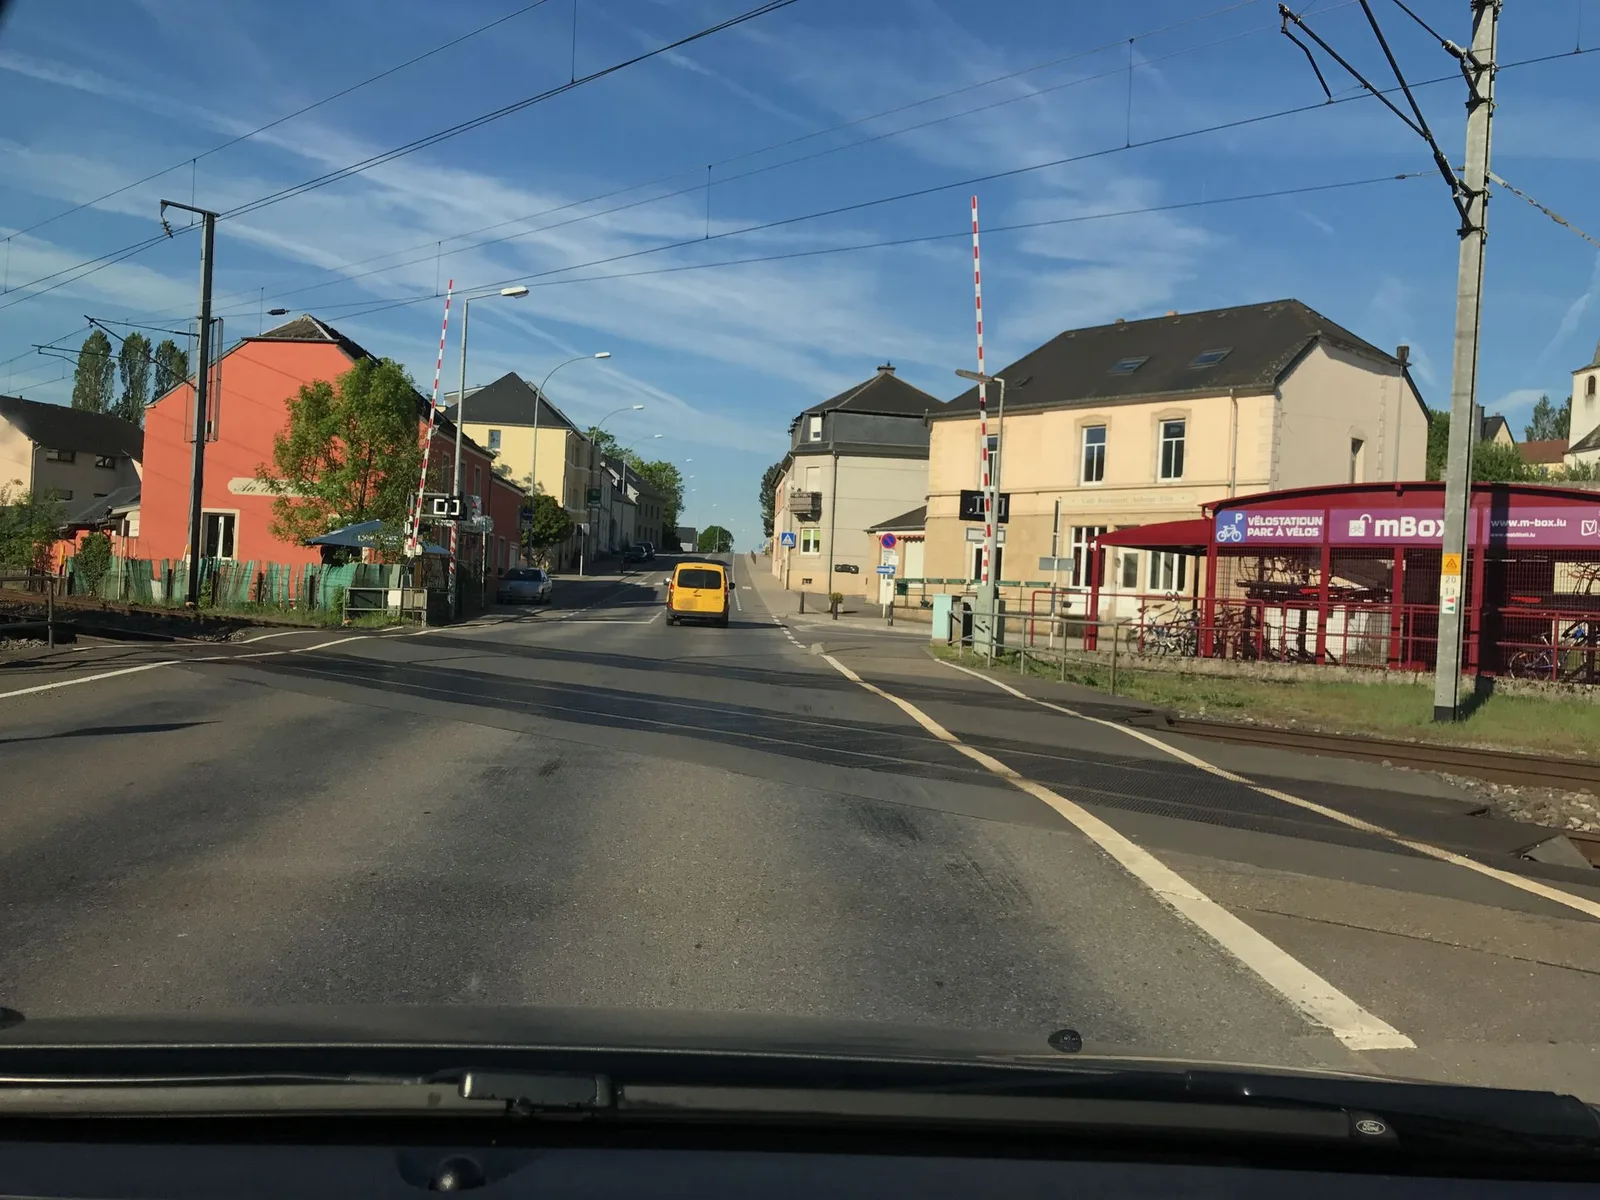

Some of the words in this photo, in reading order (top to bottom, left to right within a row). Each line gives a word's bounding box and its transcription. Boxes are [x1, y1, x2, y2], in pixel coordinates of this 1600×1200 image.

[1235, 513, 1243, 524] P
[1247, 515, 1323, 526] VËLOSTATIOUN
[1491, 518, 1567, 527] www.m-box.lu
[1247, 528, 1274, 537] PARC
[1275, 525, 1284, 537] À
[1286, 525, 1319, 537] VÉLOS
[1445, 576, 1457, 584] 20
